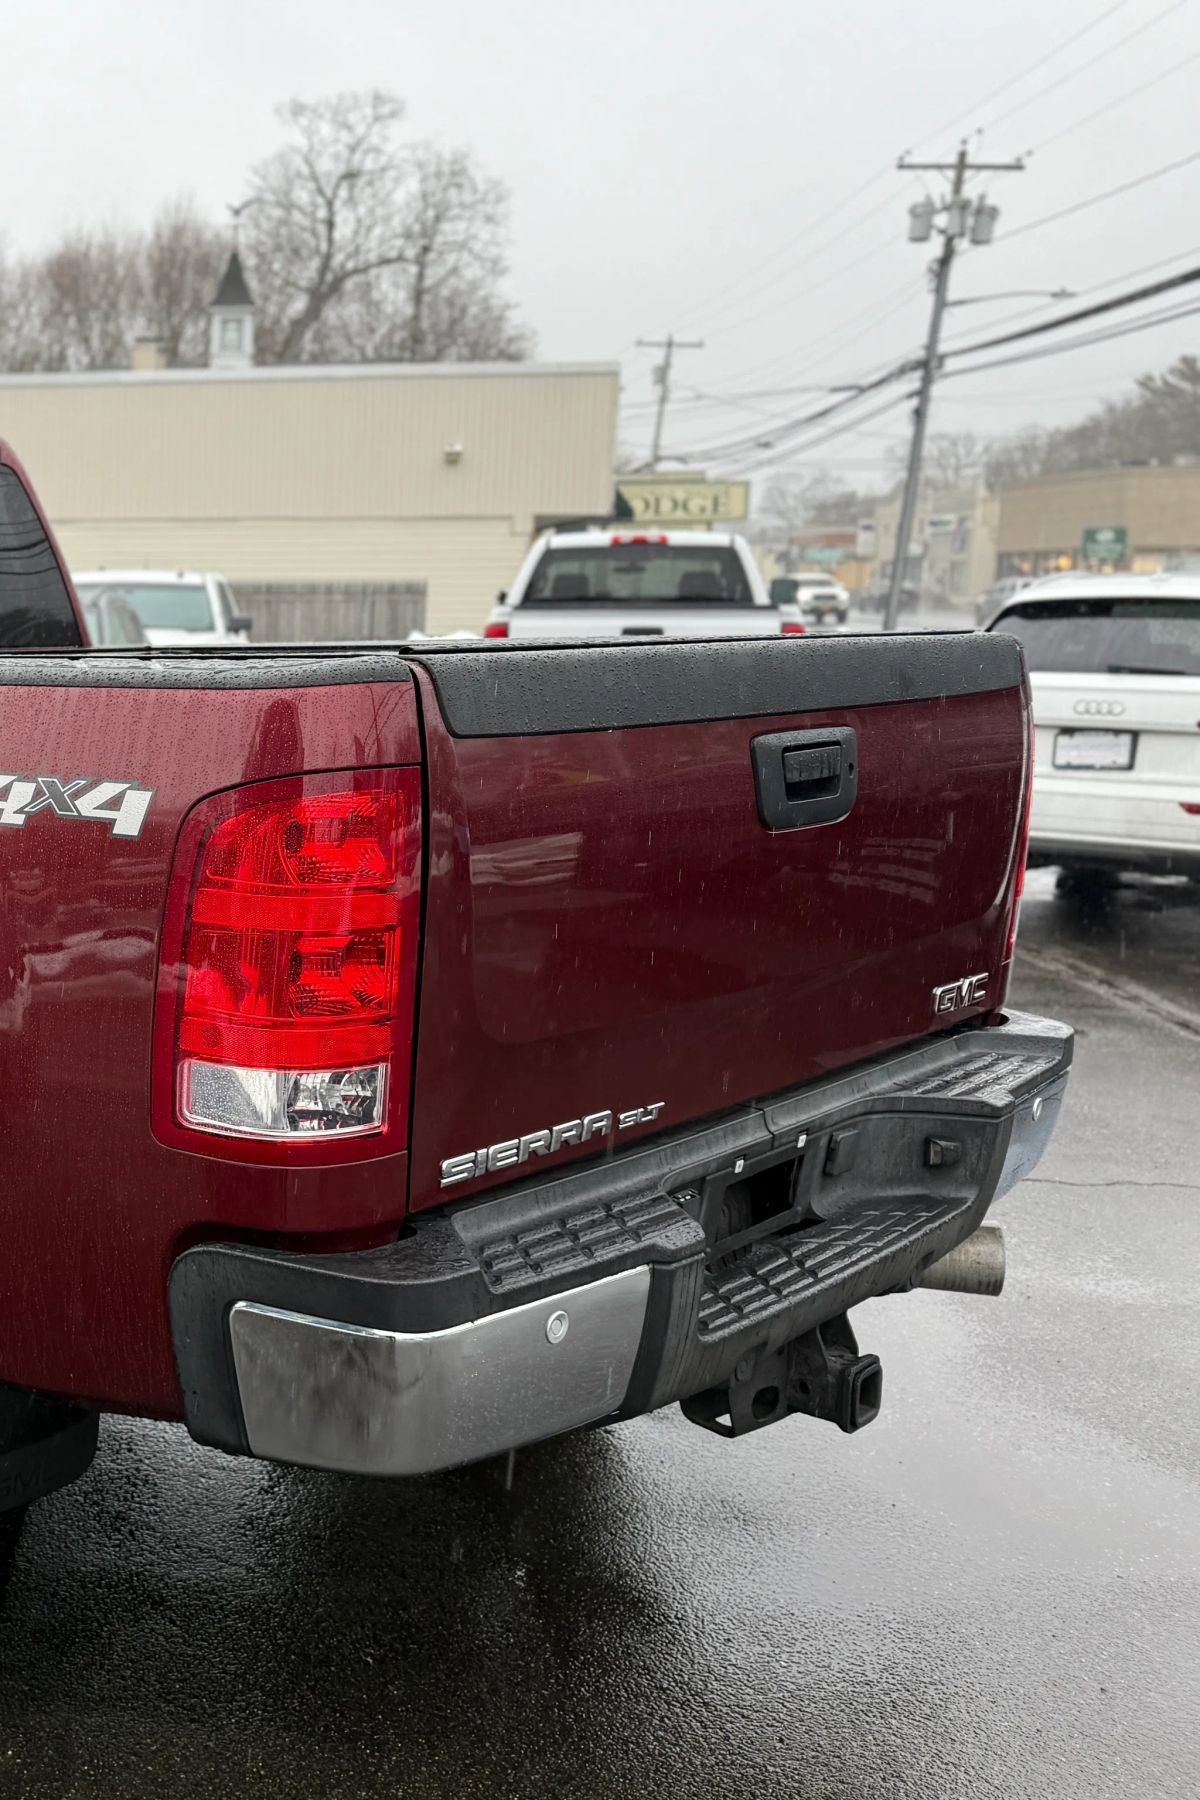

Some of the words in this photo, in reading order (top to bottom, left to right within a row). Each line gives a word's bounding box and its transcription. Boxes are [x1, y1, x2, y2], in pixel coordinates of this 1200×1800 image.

[932, 972, 989, 1015] GMC
[440, 1110, 613, 1188] SIERRA
[618, 1101, 666, 1130] SLT
